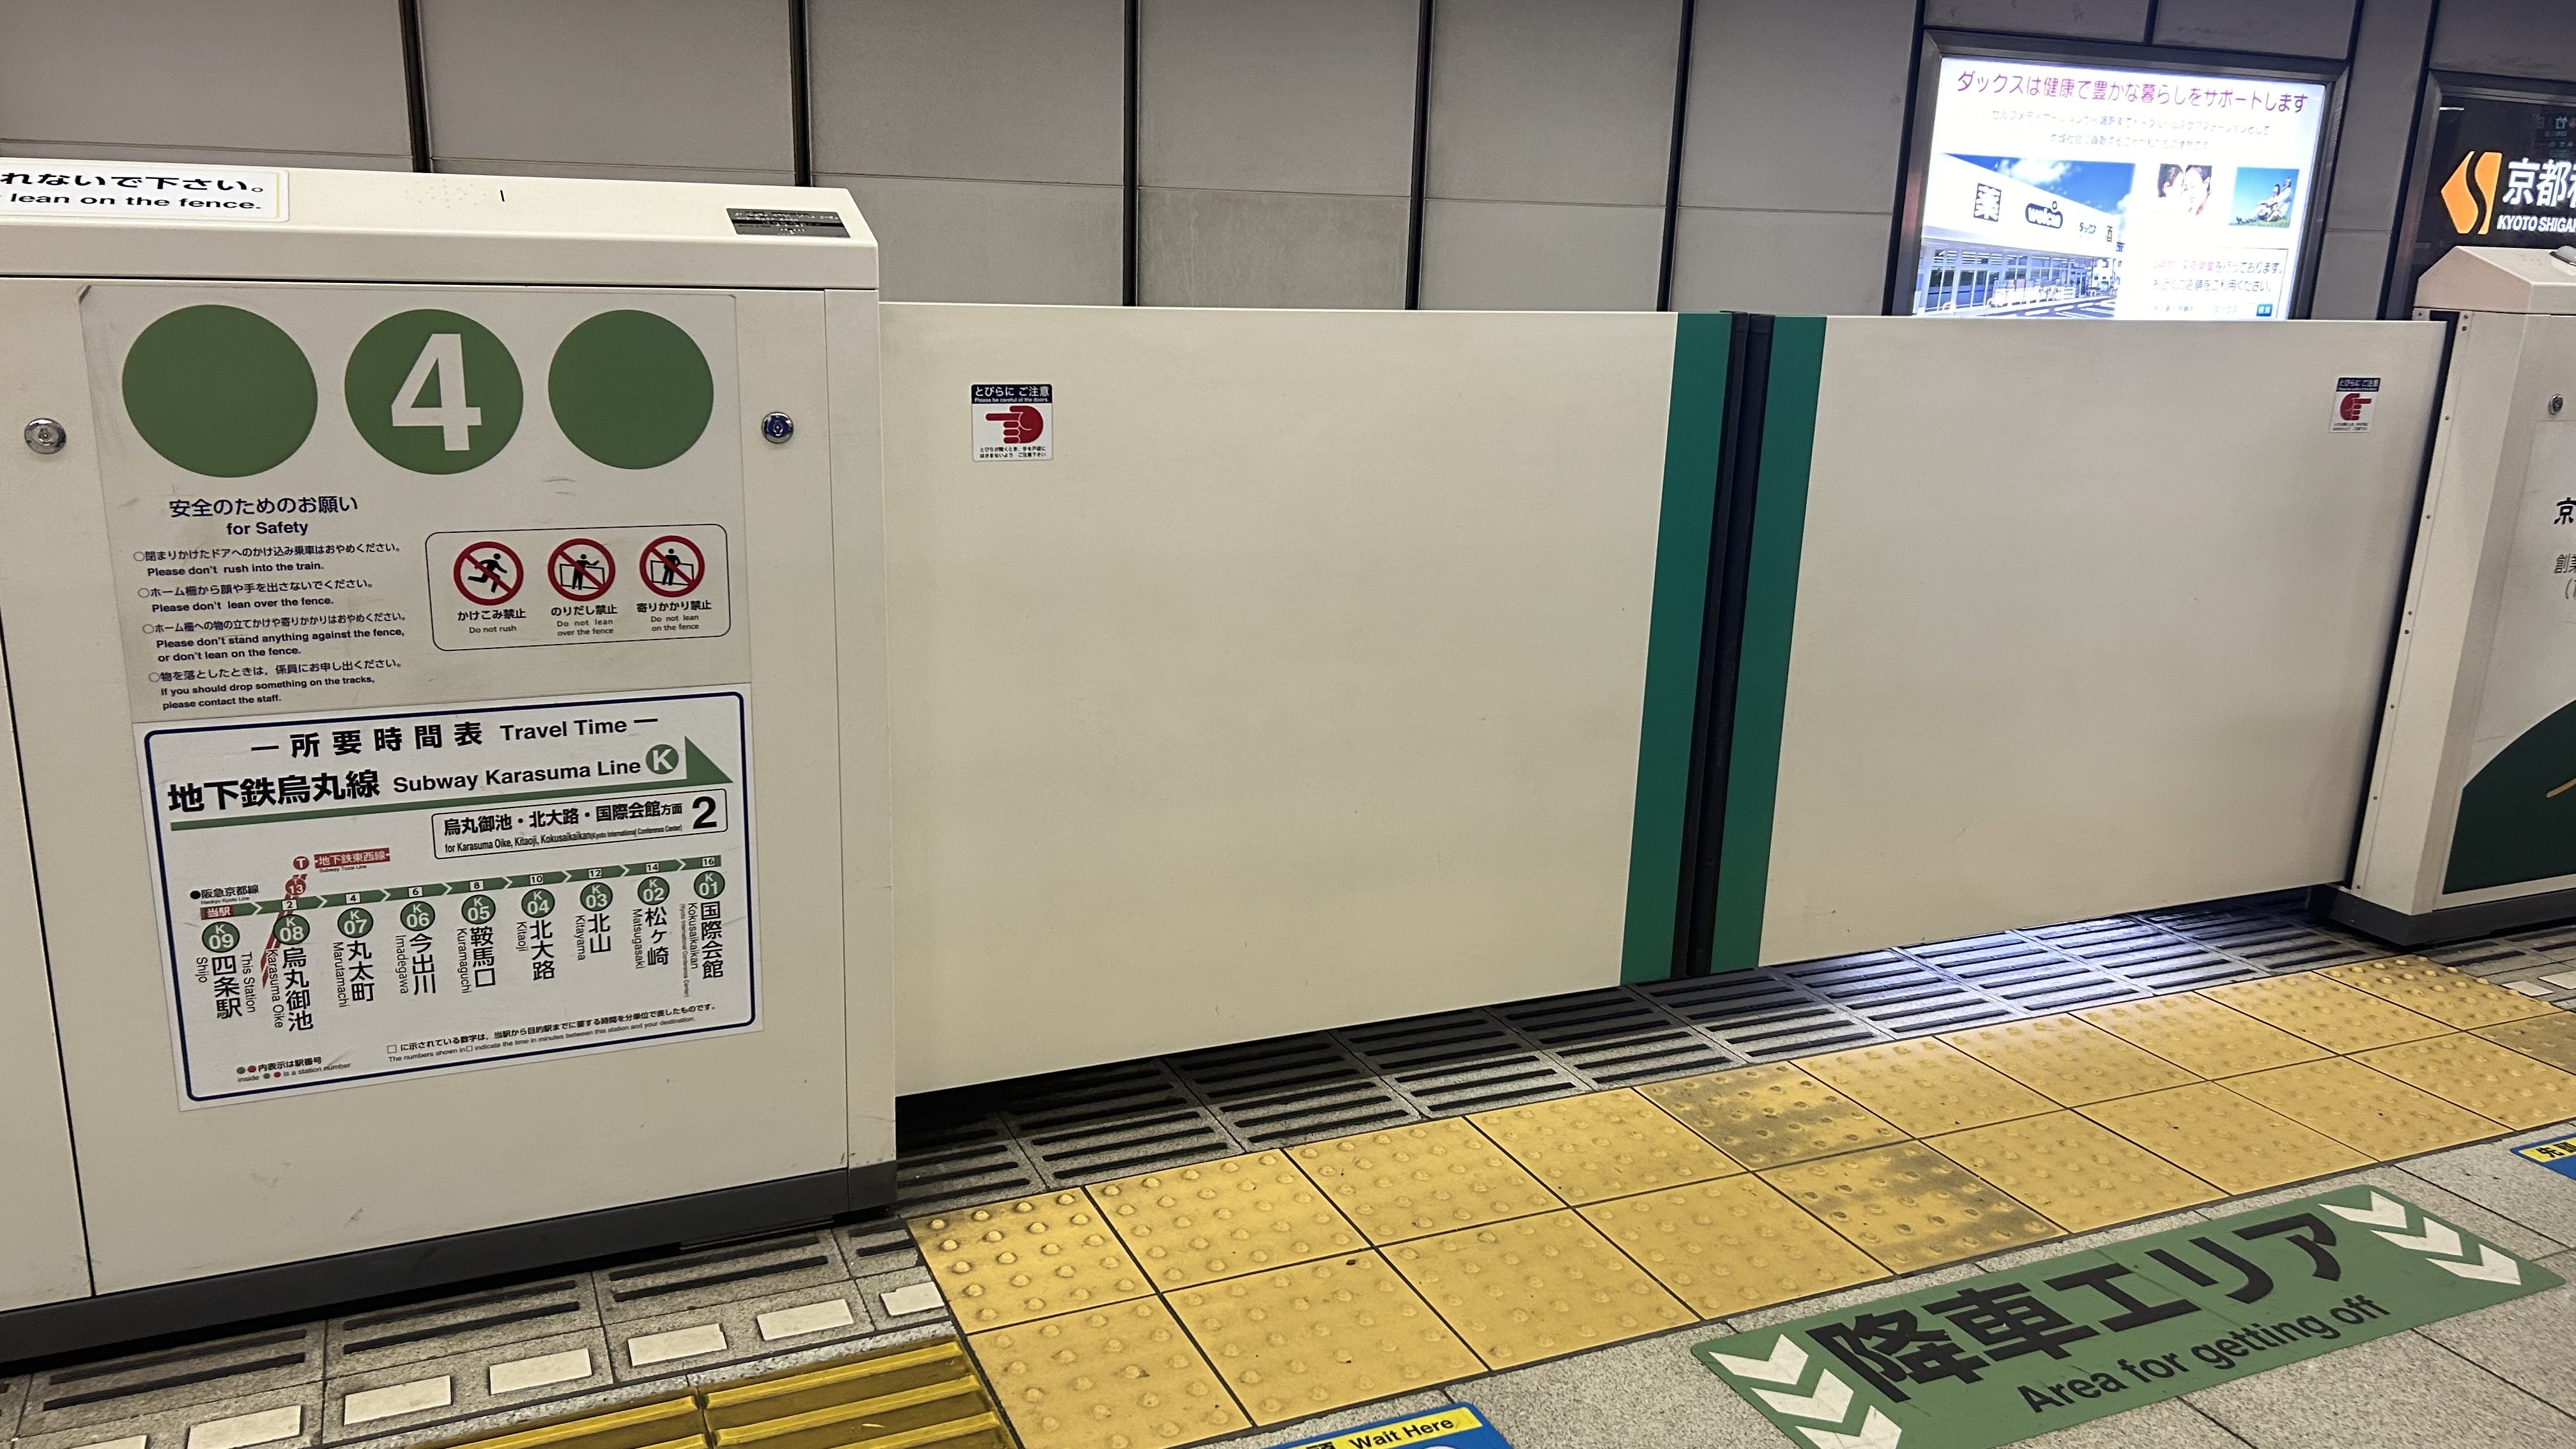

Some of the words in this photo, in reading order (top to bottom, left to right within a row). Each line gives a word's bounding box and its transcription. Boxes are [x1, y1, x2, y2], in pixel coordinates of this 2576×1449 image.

[1957, 70, 2308, 113] ダックスは健康で豊かな暮らしをサポートします
[0, 172, 263, 192] れないで下さい。
[2503, 158, 2576, 208] 京都
[10, 193, 70, 203] lean
[126, 197, 169, 206] the
[179, 198, 261, 209] fence.
[2497, 215, 2538, 231] KYOTO
[392, 334, 481, 451] 4
[976, 387, 1014, 396] とびらに
[169, 496, 358, 518] 安全のためのお願い
[226, 523, 250, 535] for
[256, 521, 308, 536] Safety
[147, 567, 185, 576] Please
[188, 565, 217, 574] don't
[224, 564, 249, 573] rush
[252, 564, 273, 572] into
[275, 563, 293, 571] the
[296, 562, 323, 570] train.
[151, 604, 189, 612] Please
[192, 601, 222, 610] don't
[227, 601, 250, 609] lean
[280, 598, 298, 606] the
[301, 597, 334, 605] fence.
[551, 604, 618, 616] のりだし禁止
[636, 599, 712, 613] 寄りかかり禁止
[457, 608, 526, 621] かけこみ禁止
[156, 640, 194, 648] Please
[196, 636, 226, 646] don't
[228, 634, 259, 644] stand
[262, 632, 309, 643] anything
[312, 630, 351, 641] against
[372, 628, 404, 636] fence,
[172, 652, 202, 661] don't
[204, 651, 228, 659] lean
[248, 648, 266, 657] the
[268, 647, 301, 656] fence.
[170, 688, 189, 697] you
[192, 684, 227, 693] should
[255, 680, 307, 689] something
[163, 702, 196, 710] please
[198, 697, 236, 707] contact
[257, 694, 281, 703] staff.
[500, 721, 567, 740] Travel
[573, 719, 627, 735] Time
[289, 721, 482, 758] 所要時間表
[652, 749, 674, 772] K
[393, 774, 479, 793] Subway
[486, 766, 590, 785] Karasuma
[597, 760, 641, 776] Line
[167, 769, 380, 813] 地下鉄烏丸線
[692, 796, 717, 830] 2
[445, 843, 455, 853] for
[457, 841, 493, 852] Karasuma
[297, 859, 305, 868] T
[647, 863, 658, 871] 14
[649, 879, 657, 888] K
[705, 873, 714, 882] K
[289, 884, 303, 894] 13
[533, 891, 543, 900] K
[592, 884, 600, 894] K
[643, 888, 664, 902] 02
[699, 882, 719, 895] 01
[413, 905, 422, 913] K
[474, 897, 483, 907] K
[527, 900, 550, 914] 04
[586, 894, 608, 908] 03
[286, 917, 296, 926] K
[350, 911, 359, 920] K
[406, 915, 429, 928] 06
[468, 907, 491, 921] 05
[216, 925, 225, 933] K
[280, 928, 303, 942] 08
[344, 921, 367, 935] 07
[588, 912, 611, 954] 北山
[209, 935, 234, 949] 09
[517, 921, 527, 952] Kitaoji
[576, 915, 586, 960] Kitayama
[632, 908, 646, 969] Matsugasaki
[701, 901, 723, 979] 国際会館
[470, 926, 496, 988] 鞍馬口
[529, 919, 555, 981] 北大路
[241, 952, 252, 974] This
[395, 935, 408, 993] Imadegawa
[410, 933, 436, 995] 今出川
[457, 928, 472, 993] Kuramaguchi
[196, 956, 208, 983] Shijo
[333, 942, 349, 1008] Marutamachi
[347, 940, 374, 1002] 丸太町
[212, 955, 243, 1019] 四条駅
[243, 977, 256, 1013] Station
[266, 949, 280, 1002] Karasuma
[273, 1005, 283, 1028] Oike
[1805, 1213, 2341, 1402] 降車エリア
[2016, 1372, 2129, 1413] Area
[2117, 1353, 2190, 1383] for
[2191, 1315, 2342, 1370] getting
[2329, 1294, 2391, 1325] off
[1349, 1430, 1401, 1449] Wait
[1405, 1419, 1454, 1438] Here
